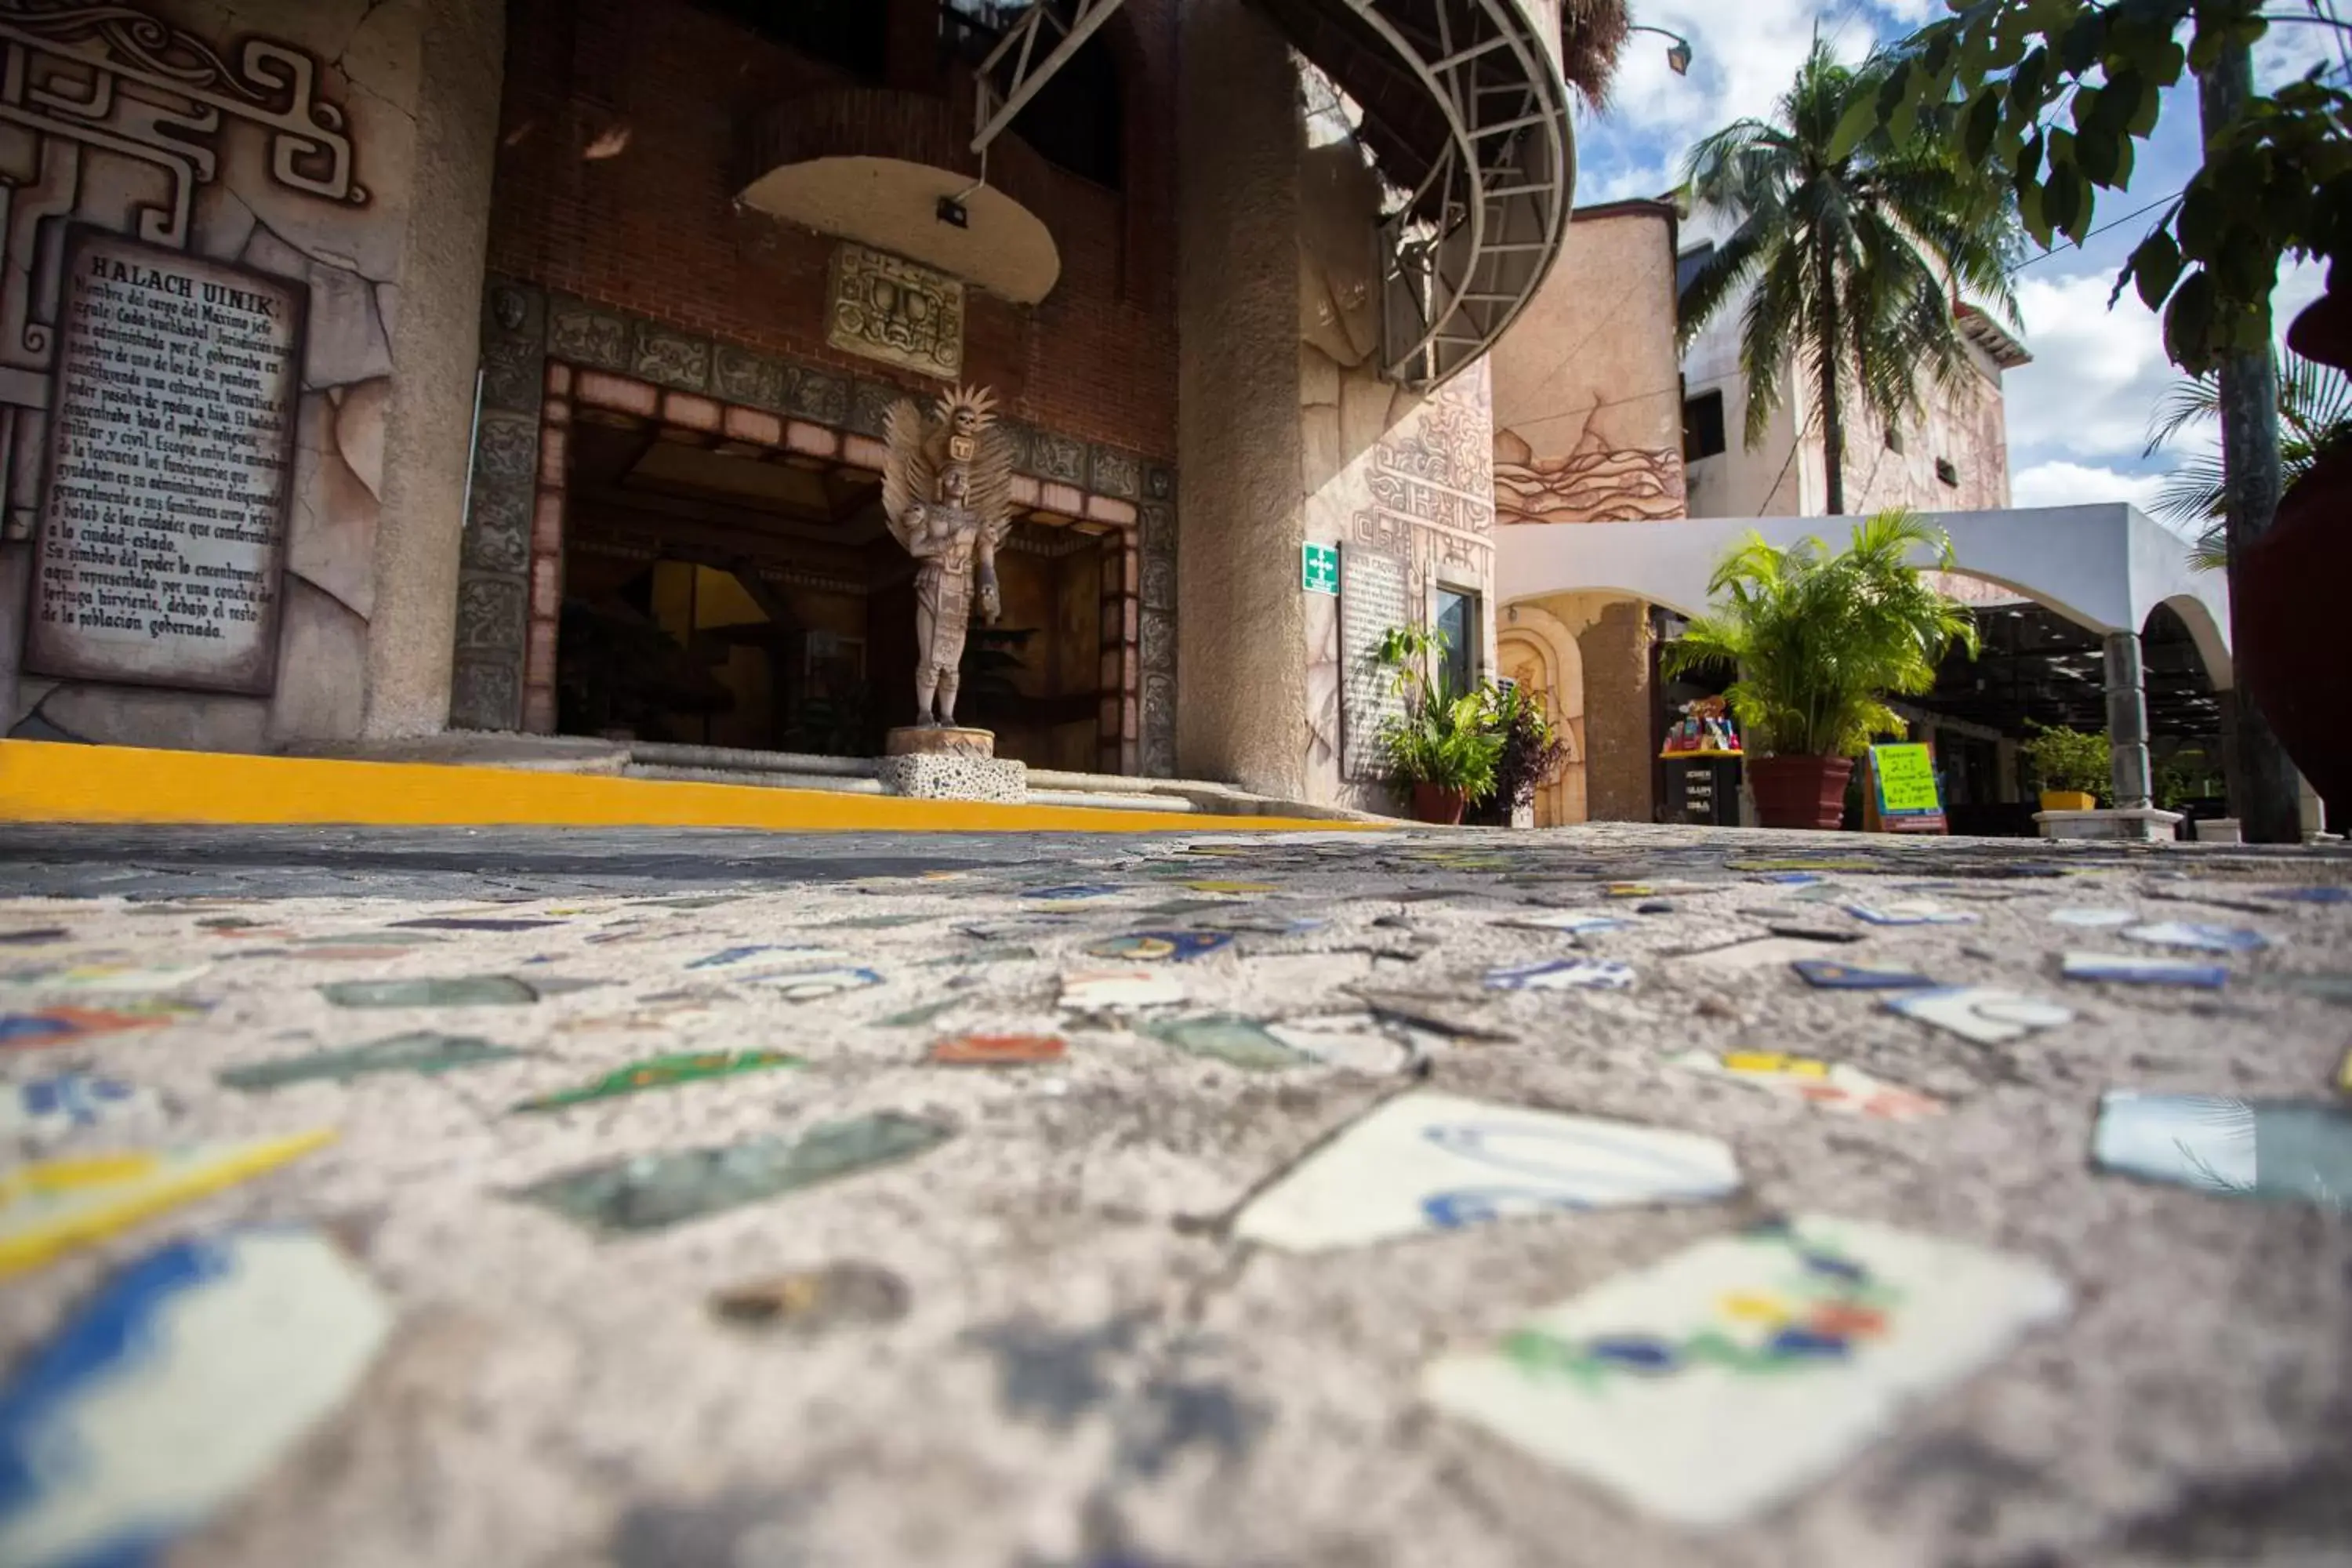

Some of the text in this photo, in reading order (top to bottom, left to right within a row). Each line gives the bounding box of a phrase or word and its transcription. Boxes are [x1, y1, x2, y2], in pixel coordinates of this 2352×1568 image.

[91, 256, 281, 319] HALACH UINIK:
[127, 288, 145, 307] del
[181, 299, 198, 319] del
[114, 345, 128, 363] de
[153, 354, 168, 372] de
[186, 359, 200, 379] de
[169, 341, 188, 358] por
[206, 347, 261, 371] gobernaba
[65, 378, 97, 398] poder
[104, 430, 118, 446] y
[164, 415, 175, 432] el
[52, 477, 131, 504] generalmente
[132, 495, 142, 507] a
[143, 497, 162, 511] sus
[116, 473, 131, 485] en
[132, 474, 146, 488] su
[229, 470, 249, 490] que
[102, 505, 117, 524] de
[137, 510, 185, 534] ciudades
[188, 522, 210, 540] que
[45, 540, 64, 559] Su
[119, 548, 138, 568] del
[140, 553, 176, 577] poder
[78, 569, 158, 590] representado
[161, 581, 183, 599] por
[185, 583, 210, 597] una
[41, 601, 57, 622] de
[61, 604, 74, 623] la
[78, 604, 143, 630] población
[166, 594, 208, 619] debajo
[212, 600, 225, 619] el
